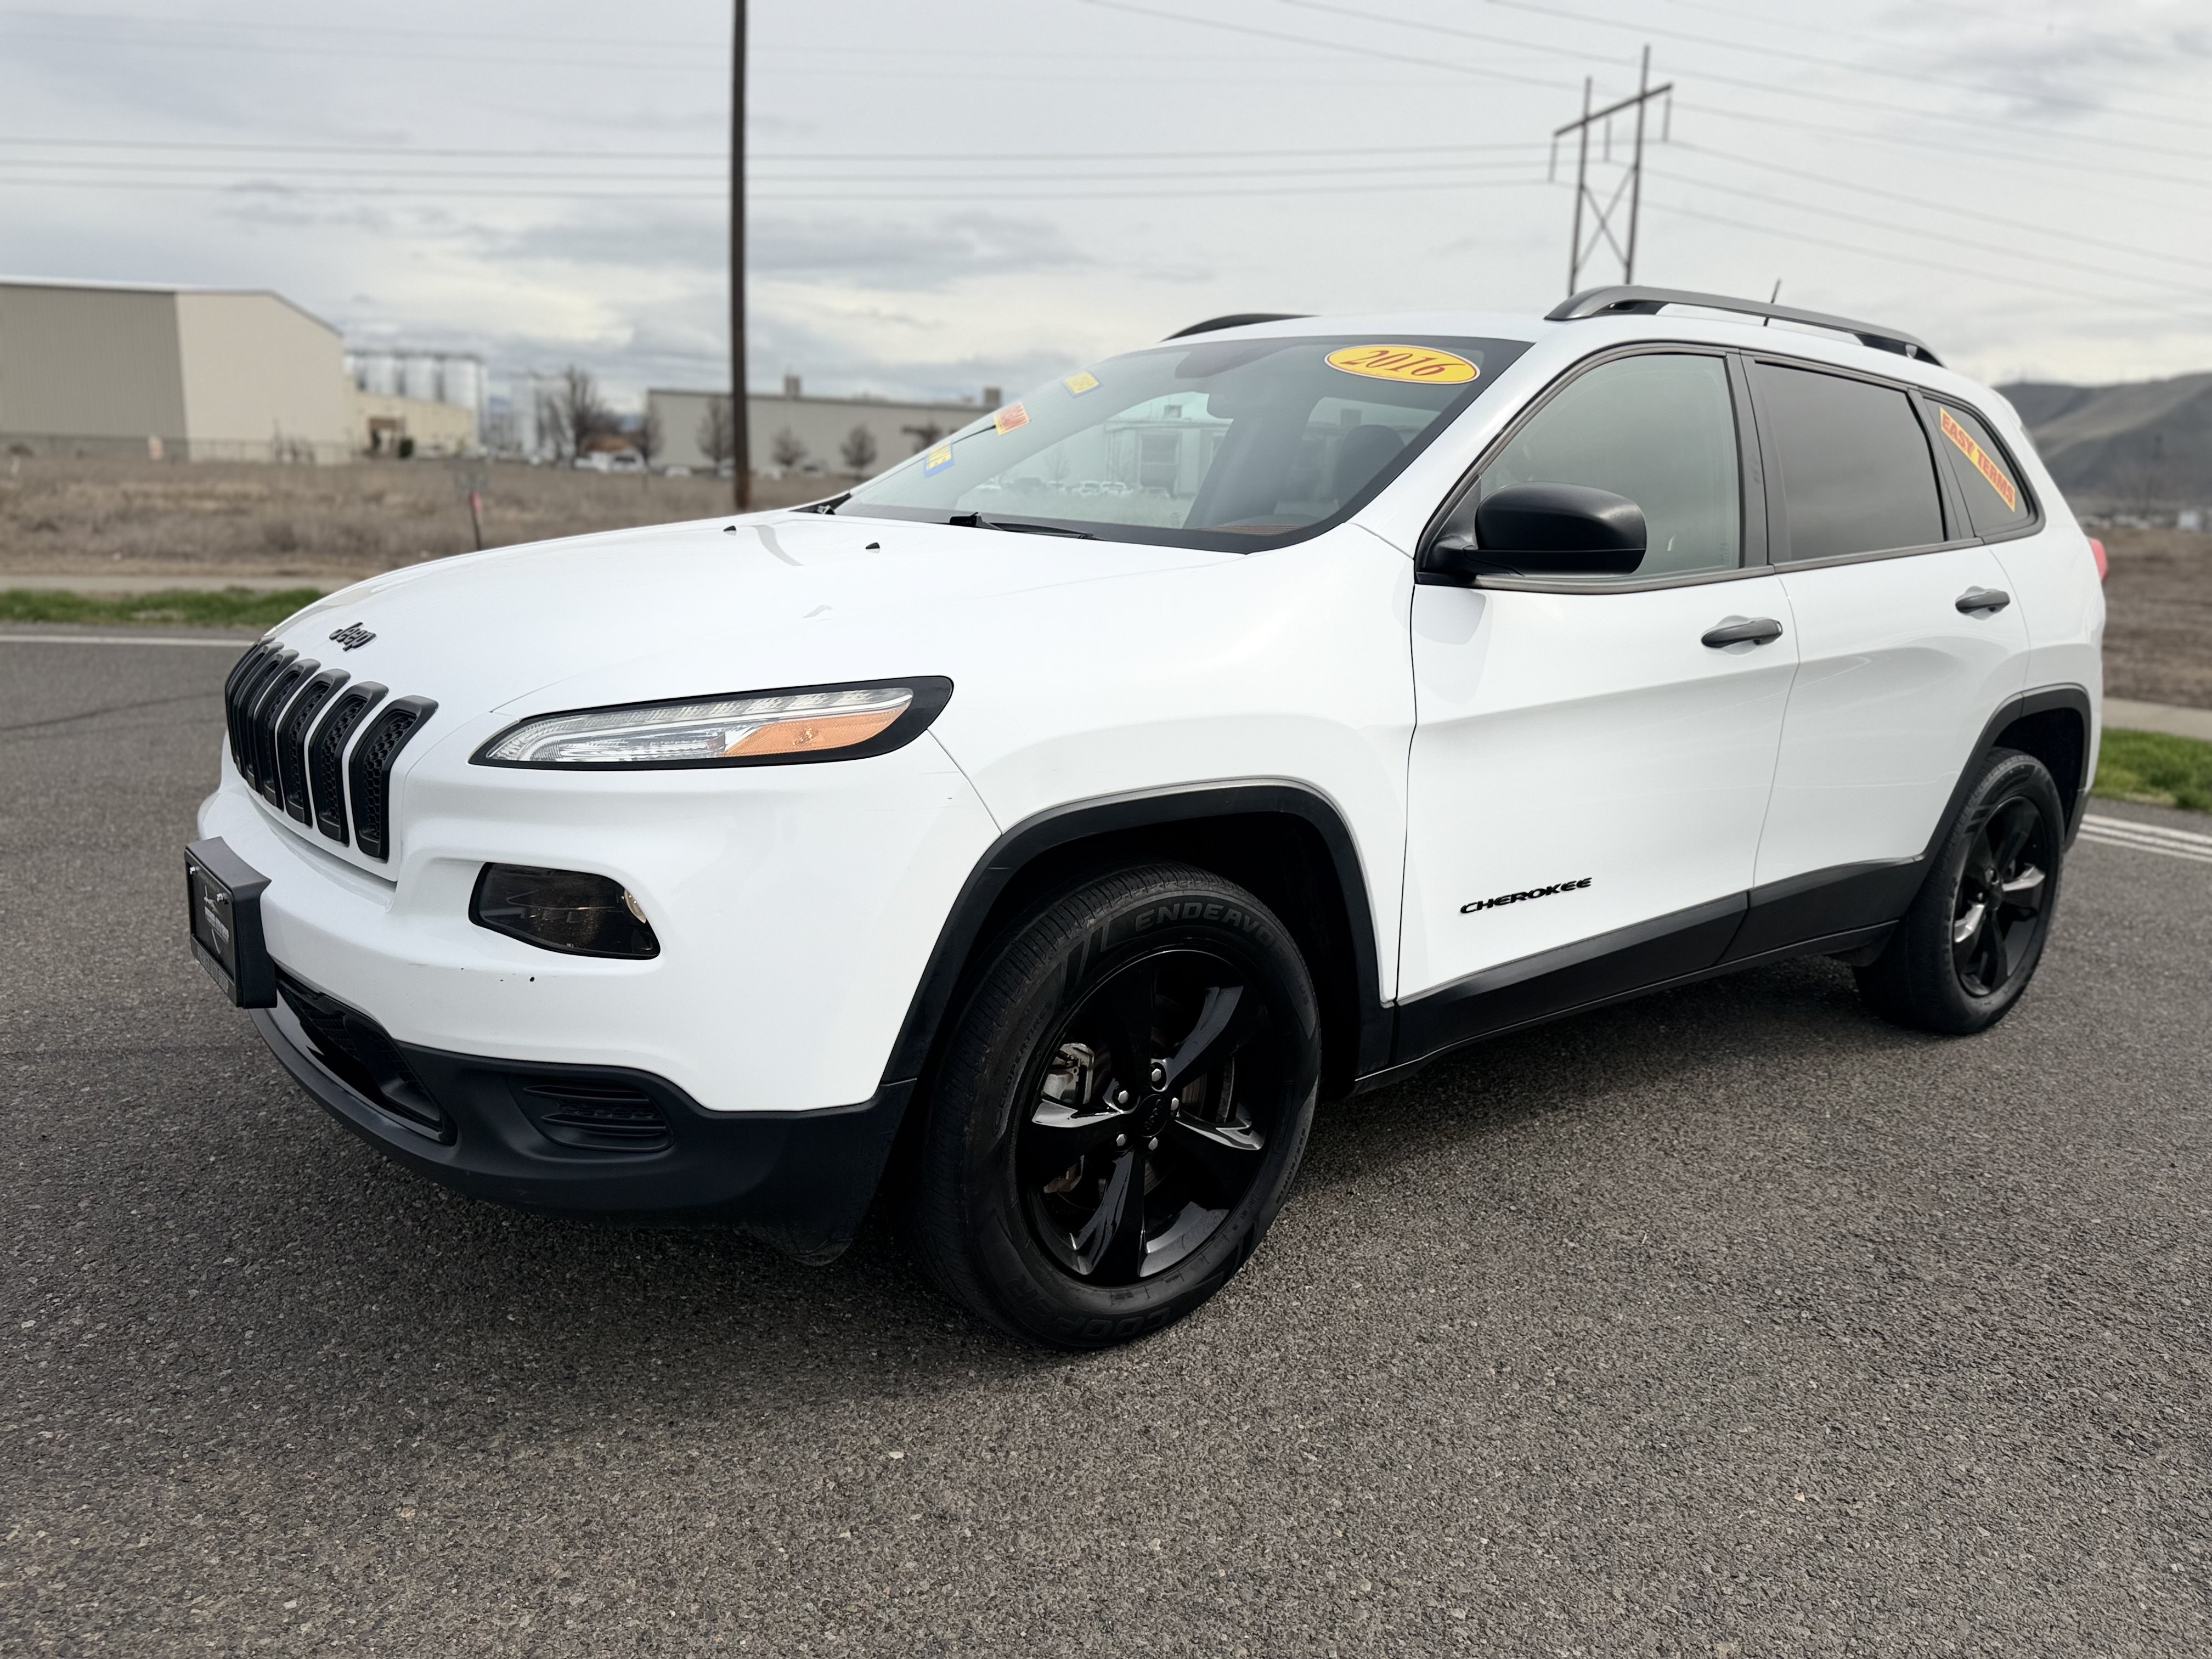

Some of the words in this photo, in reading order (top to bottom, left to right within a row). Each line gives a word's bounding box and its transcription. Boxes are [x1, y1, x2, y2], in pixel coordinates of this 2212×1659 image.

[1339, 350, 1466, 376] 2016
[1942, 413, 1974, 457] EASY
[1977, 448, 2014, 503] TERMS
[329, 622, 377, 652] Jeep
[1460, 877, 1593, 914] CHEROKEE
